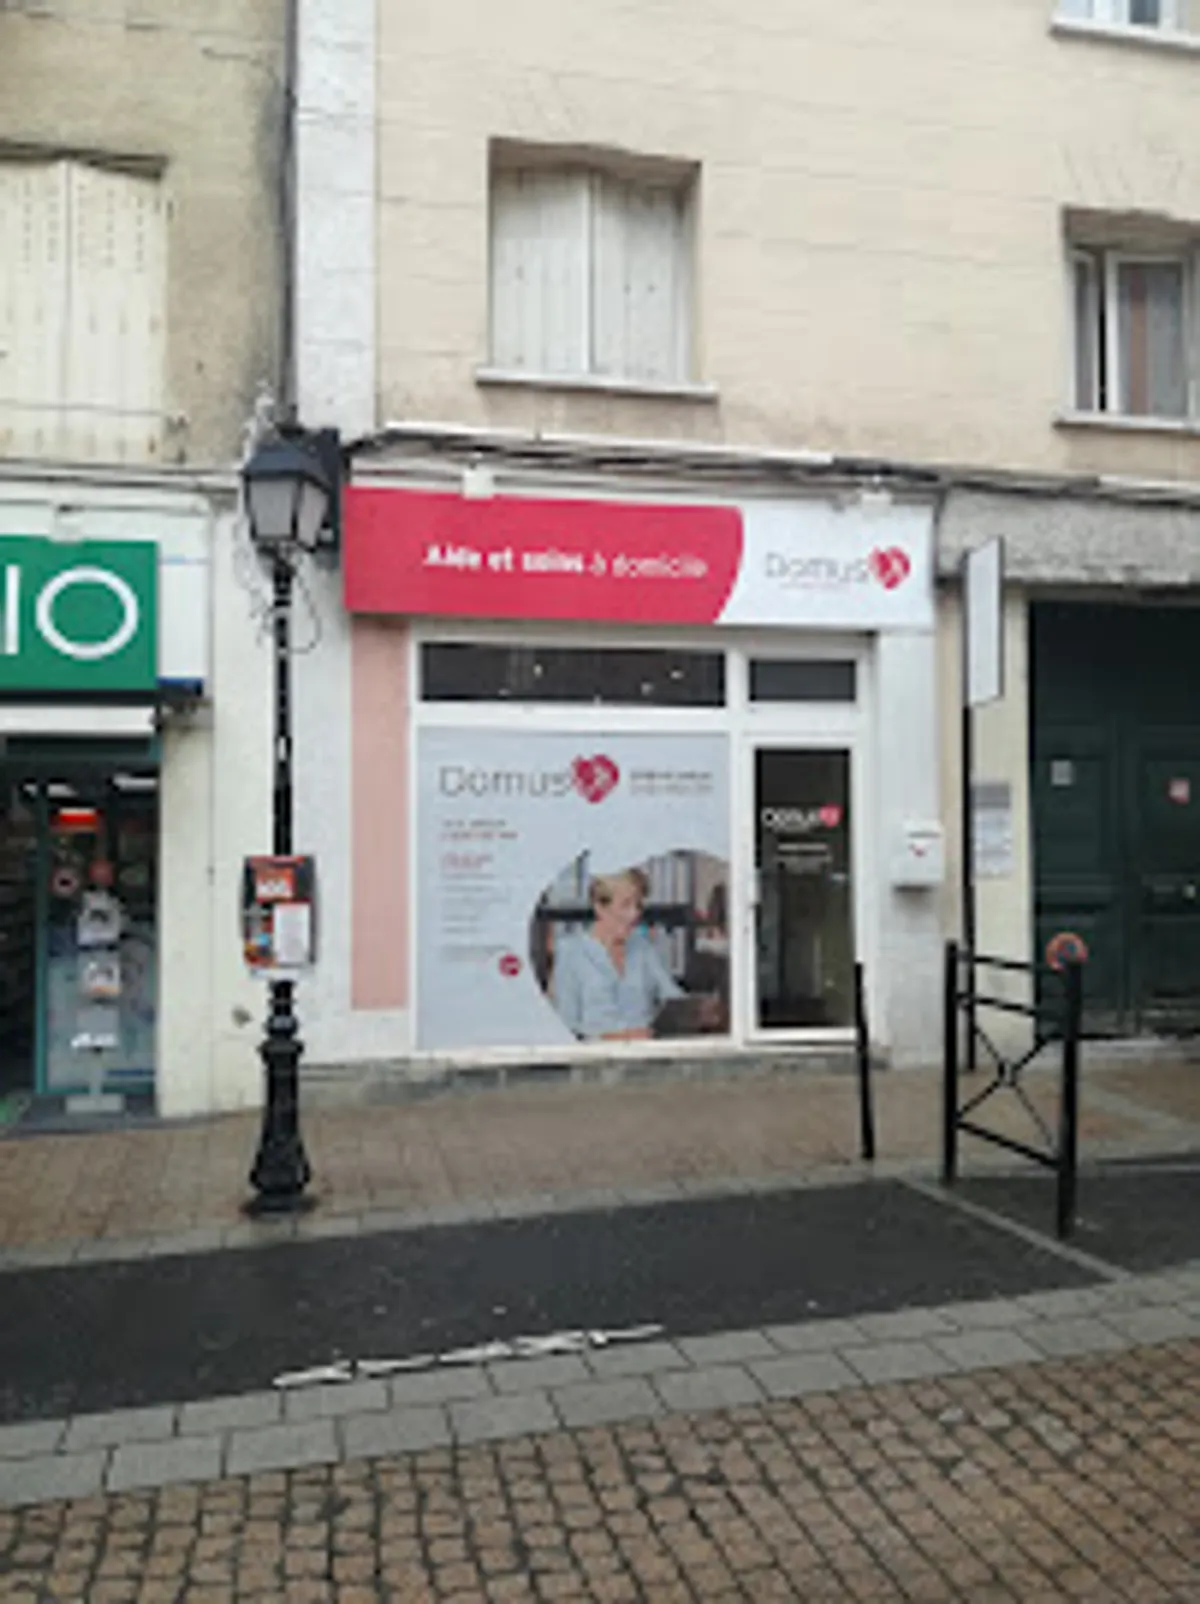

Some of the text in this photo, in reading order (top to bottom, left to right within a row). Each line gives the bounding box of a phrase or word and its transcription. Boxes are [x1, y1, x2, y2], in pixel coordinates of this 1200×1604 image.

[488, 546, 514, 571] et
[765, 552, 868, 583] Domus
[438, 766, 573, 797] Domus
